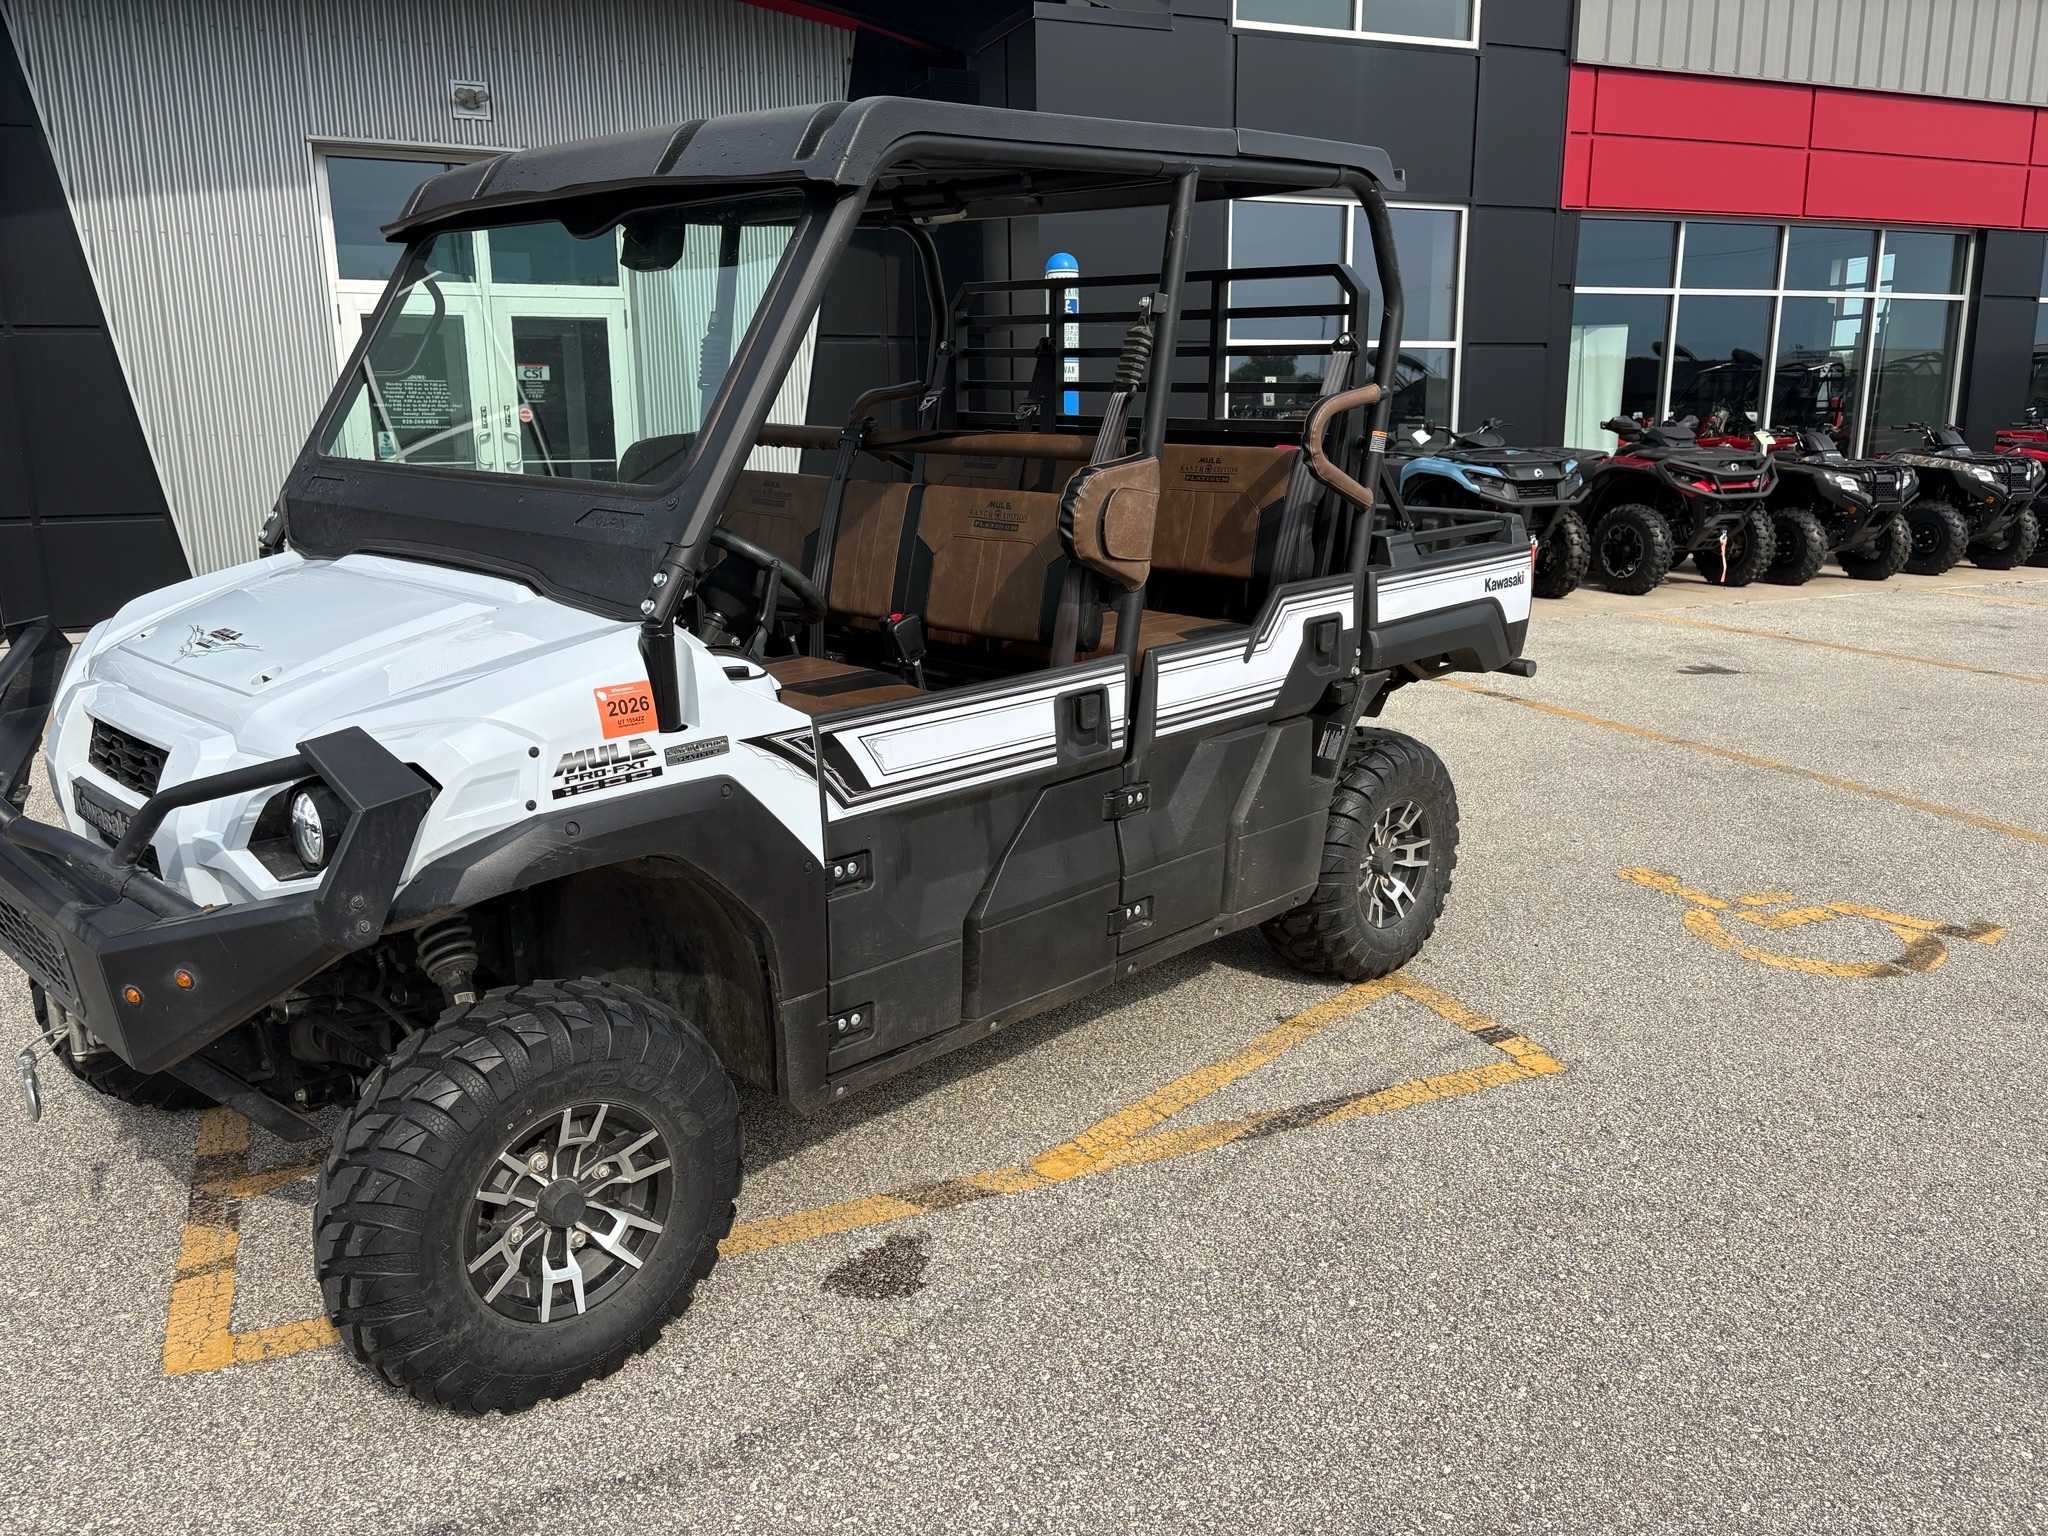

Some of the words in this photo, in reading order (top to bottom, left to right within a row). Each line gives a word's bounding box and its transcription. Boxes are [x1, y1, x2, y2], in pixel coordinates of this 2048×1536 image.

[968, 508, 993, 518] RANCH
[1003, 512, 1029, 521] EDITION
[987, 500, 1012, 510] MULE
[974, 521, 1018, 531] PLATINUM
[1484, 570, 1525, 593] Kawasaki
[606, 695, 650, 718] 2026
[552, 737, 657, 779] MULE
[677, 748, 720, 762] PLATINUM
[562, 768, 654, 797] 1000
[564, 759, 649, 785] PRO-FXT
[586, 1068, 703, 1136] DURO
